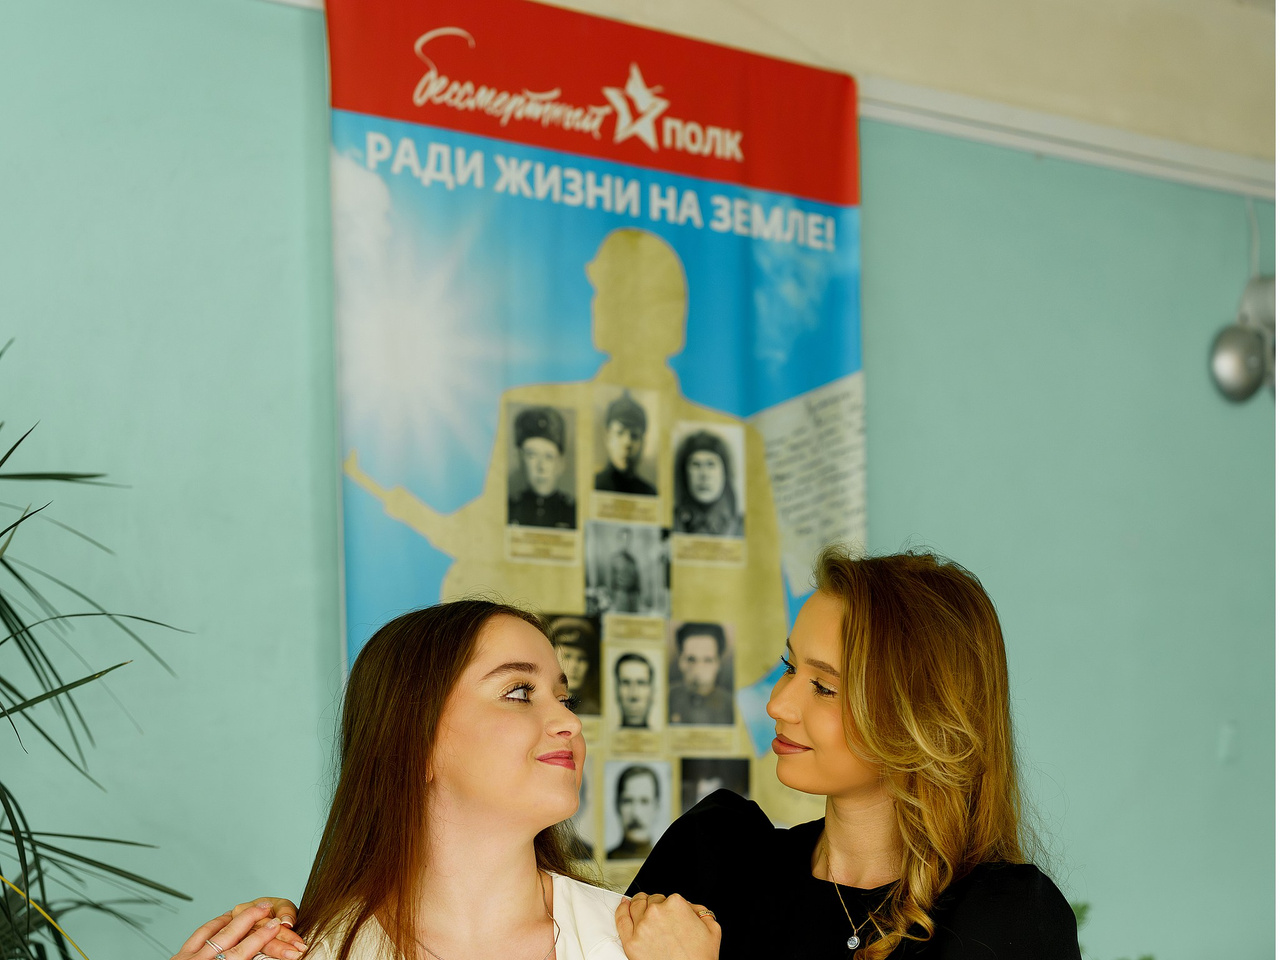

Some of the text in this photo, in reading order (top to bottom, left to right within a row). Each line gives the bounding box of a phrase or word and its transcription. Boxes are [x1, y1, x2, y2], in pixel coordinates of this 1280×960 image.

[662, 116, 745, 162] ПОЛК
[365, 131, 836, 252] РАДИ ЖИЗНИ НА ЗЕМЛЕ!
